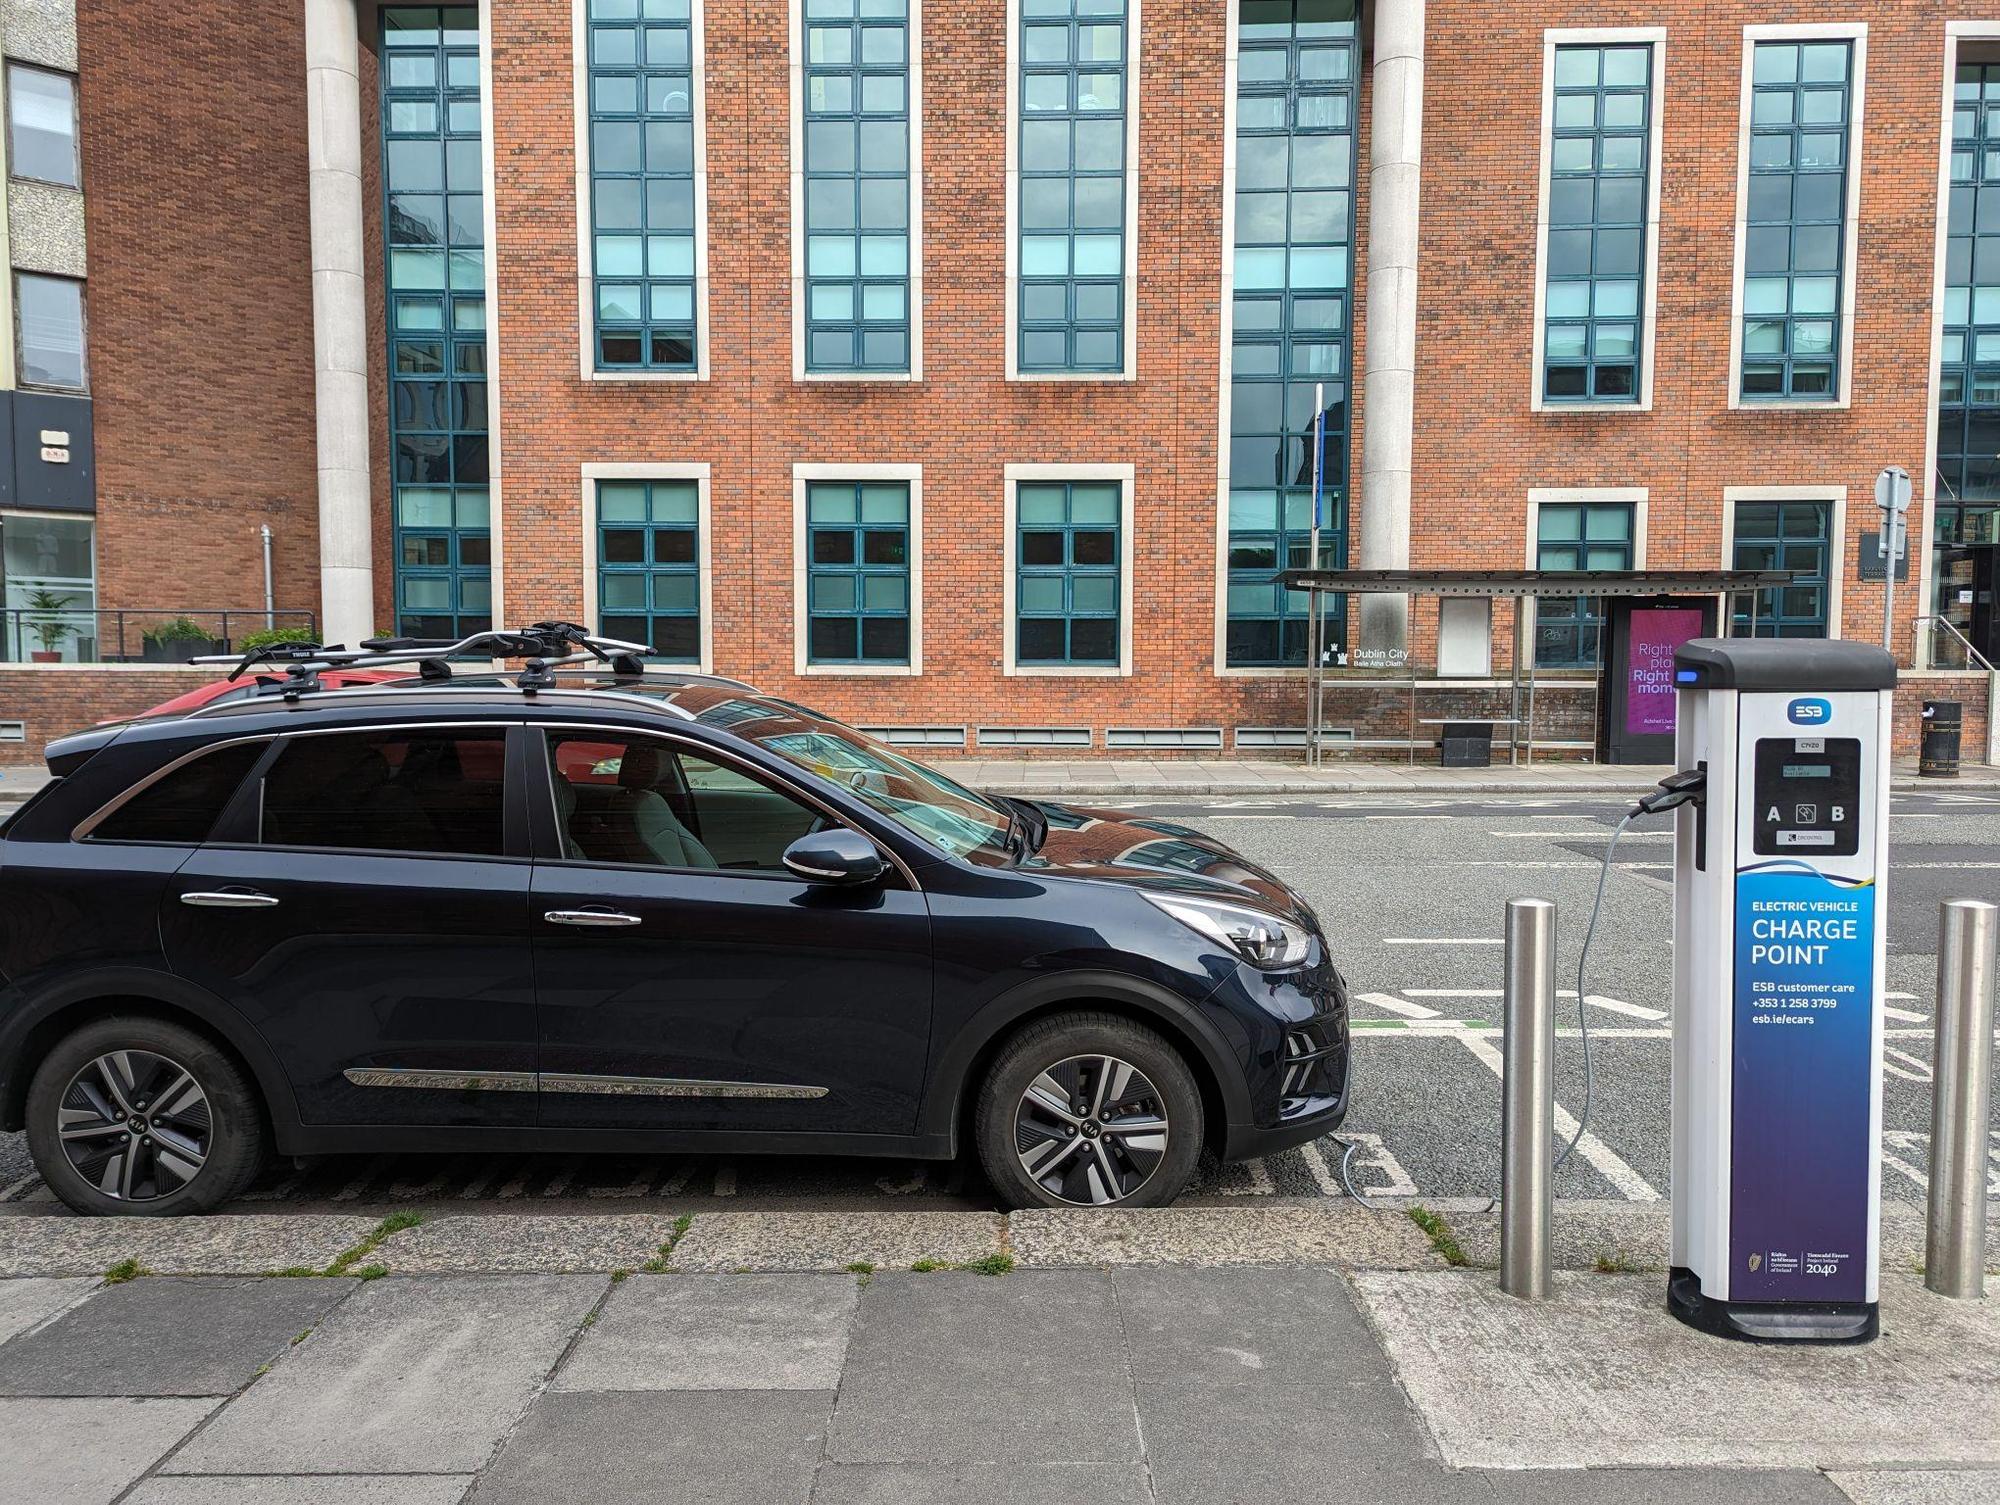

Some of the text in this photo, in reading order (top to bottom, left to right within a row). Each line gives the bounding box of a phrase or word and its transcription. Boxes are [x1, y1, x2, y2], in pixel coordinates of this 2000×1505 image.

[1354, 649, 1409, 660] Dublin City
[1639, 643, 1672, 657] Right
[1651, 658, 1675, 670] pla
[1633, 670, 1669, 684] Right
[1638, 684, 1677, 694] mom
[1796, 706, 1823, 717] ESB
[1767, 806, 1781, 821] A
[1832, 806, 1845, 821] B
[1752, 901, 1858, 912] ELECTRIC VEHICLE
[1752, 919, 1858, 939] CHARGE
[1752, 945, 1829, 965] POINT
[1752, 982, 1855, 993] ESB customer care
[1752, 998, 1837, 1009] +353 1 258 3799
[1752, 1014, 1815, 1024] esb.ie/ecars
[130, 1118, 145, 1131] KIA
[1083, 1122, 1098, 1136] KIA
[1806, 1264, 1837, 1277] 2040
